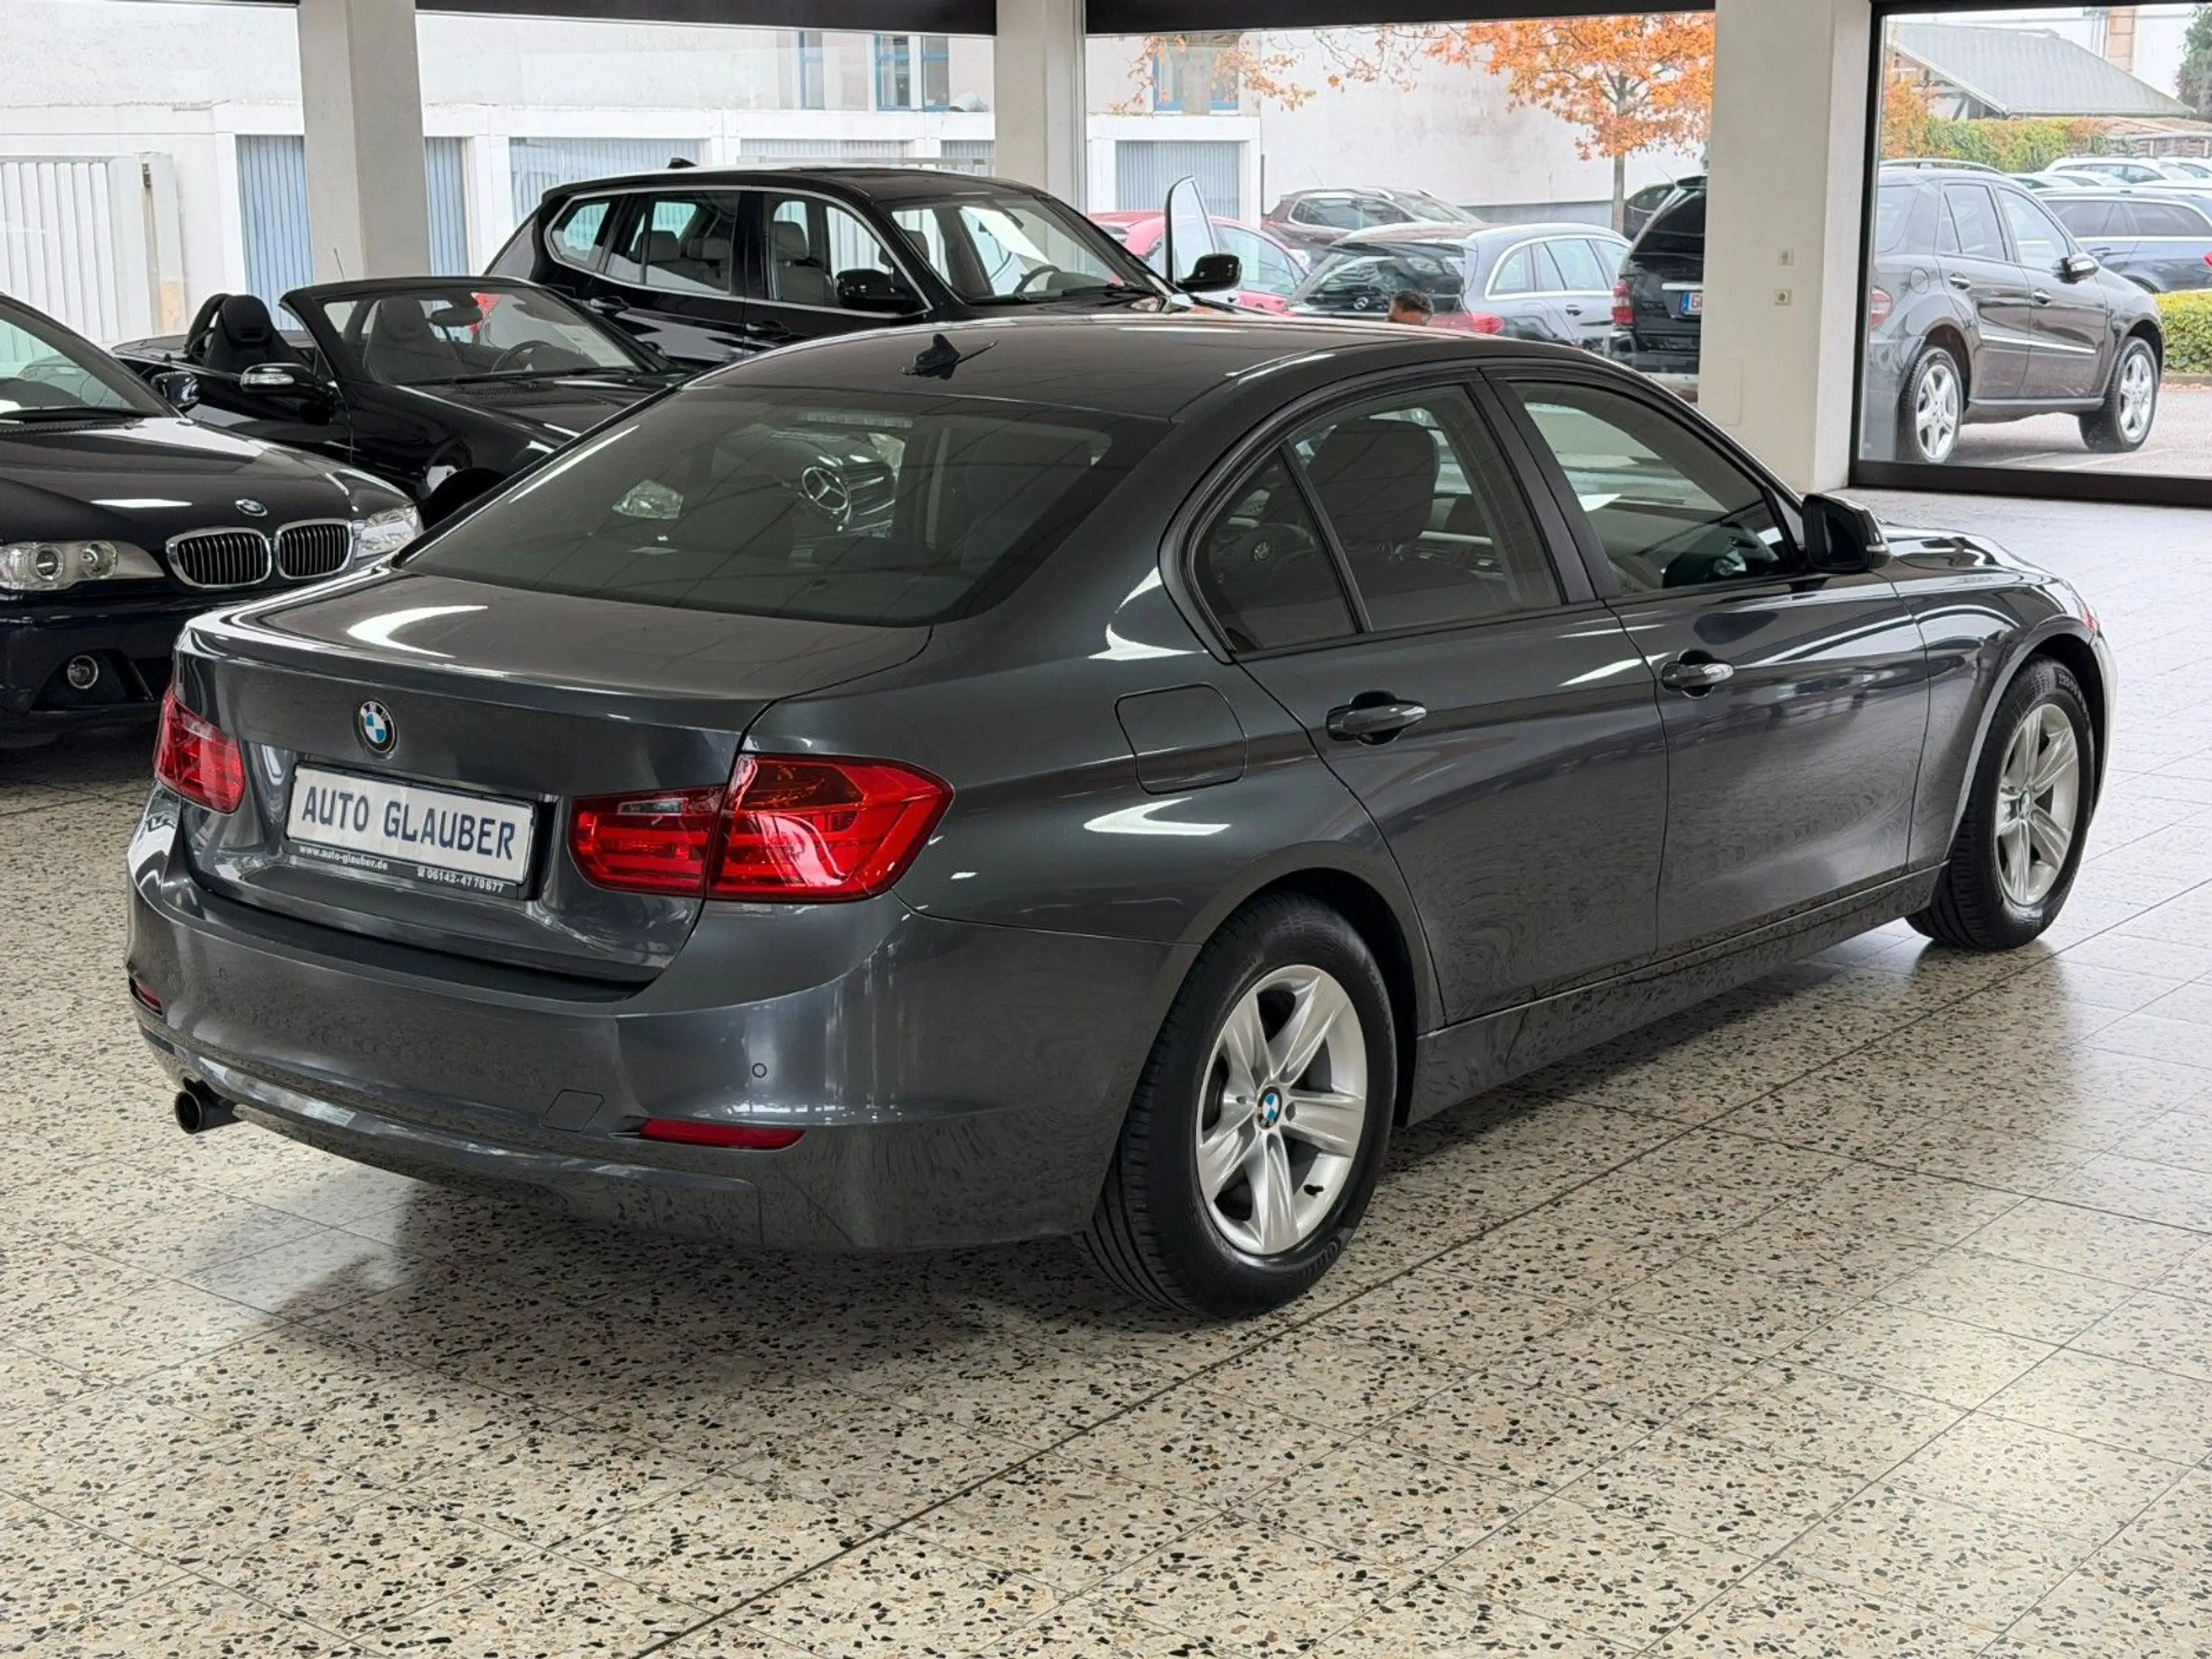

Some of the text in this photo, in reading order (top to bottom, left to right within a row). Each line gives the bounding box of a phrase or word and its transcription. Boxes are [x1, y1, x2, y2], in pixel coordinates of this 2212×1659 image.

[302, 786, 515, 860] AUTO GLAUBER
[299, 845, 388, 870] www.auto-glauber.de
